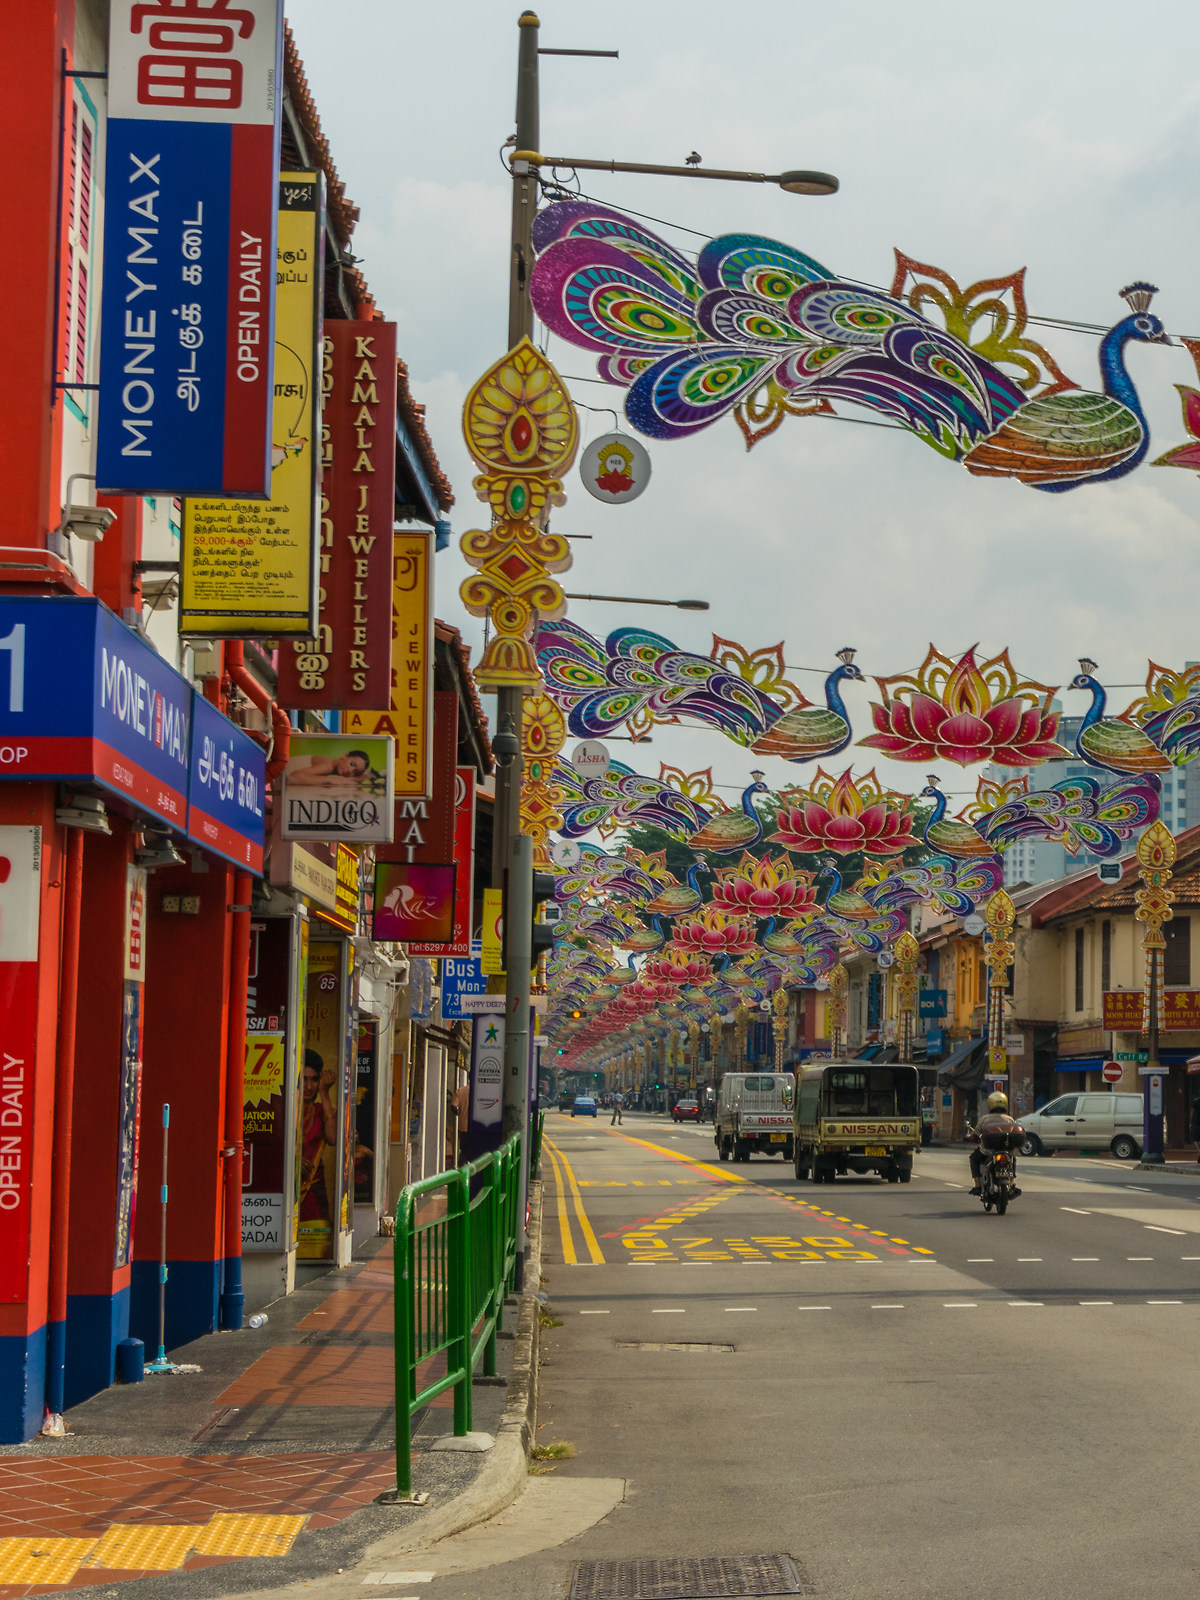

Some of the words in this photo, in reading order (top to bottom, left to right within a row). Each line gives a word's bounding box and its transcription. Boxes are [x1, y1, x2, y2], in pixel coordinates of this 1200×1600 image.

[182, 201, 203, 285] கடை
[239, 231, 262, 303] DAILY
[121, 152, 160, 457] MONEYMAX
[172, 303, 204, 412] அடகுக்
[237, 311, 260, 382] OPEN
[350, 336, 379, 472] KAMALA
[347, 485, 377, 691] JEWELLERS
[406, 623, 420, 783] JEWELLERS
[288, 799, 378, 825] INDIGO
[320, 978, 335, 990] 85
[446, 959, 475, 977] Bus
[448, 944, 468, 952] 7400
[306, 1002, 329, 1019] ple
[446, 994, 462, 1006] 7.3
[1, 1052, 24, 1127] DAILY
[842, 1125, 898, 1134] NISSAN
[0, 1136, 22, 1210] OPEN
